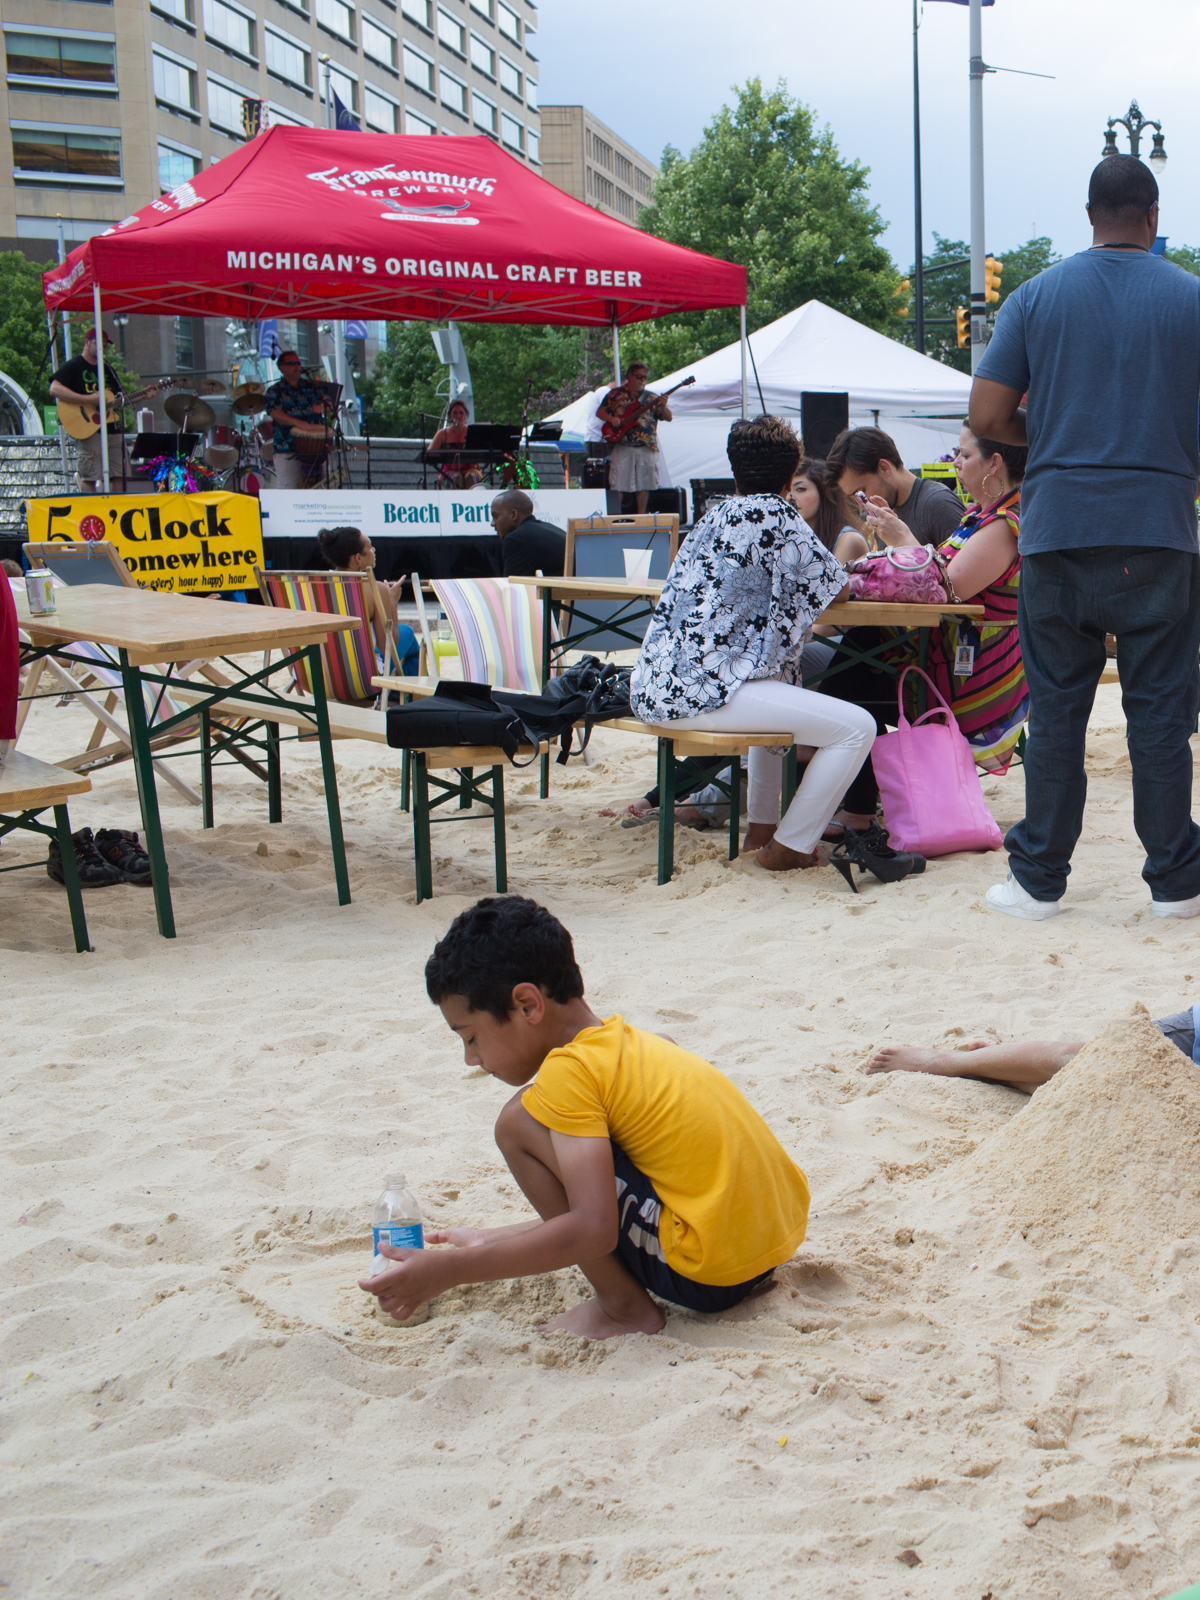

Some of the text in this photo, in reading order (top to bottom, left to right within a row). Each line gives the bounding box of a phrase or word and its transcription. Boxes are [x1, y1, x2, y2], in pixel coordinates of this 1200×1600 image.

[306, 163, 497, 196] Frankenmuth
[353, 185, 469, 197] BREWERY
[227, 250, 642, 288] MICHIGAN'S ORIGINAL CRAFT BEER
[383, 502, 492, 523] Beach Part
[116, 540, 258, 573] omewhere
[178, 576, 198, 588] hour
[201, 573, 224, 588] happy
[228, 573, 247, 585] hour
